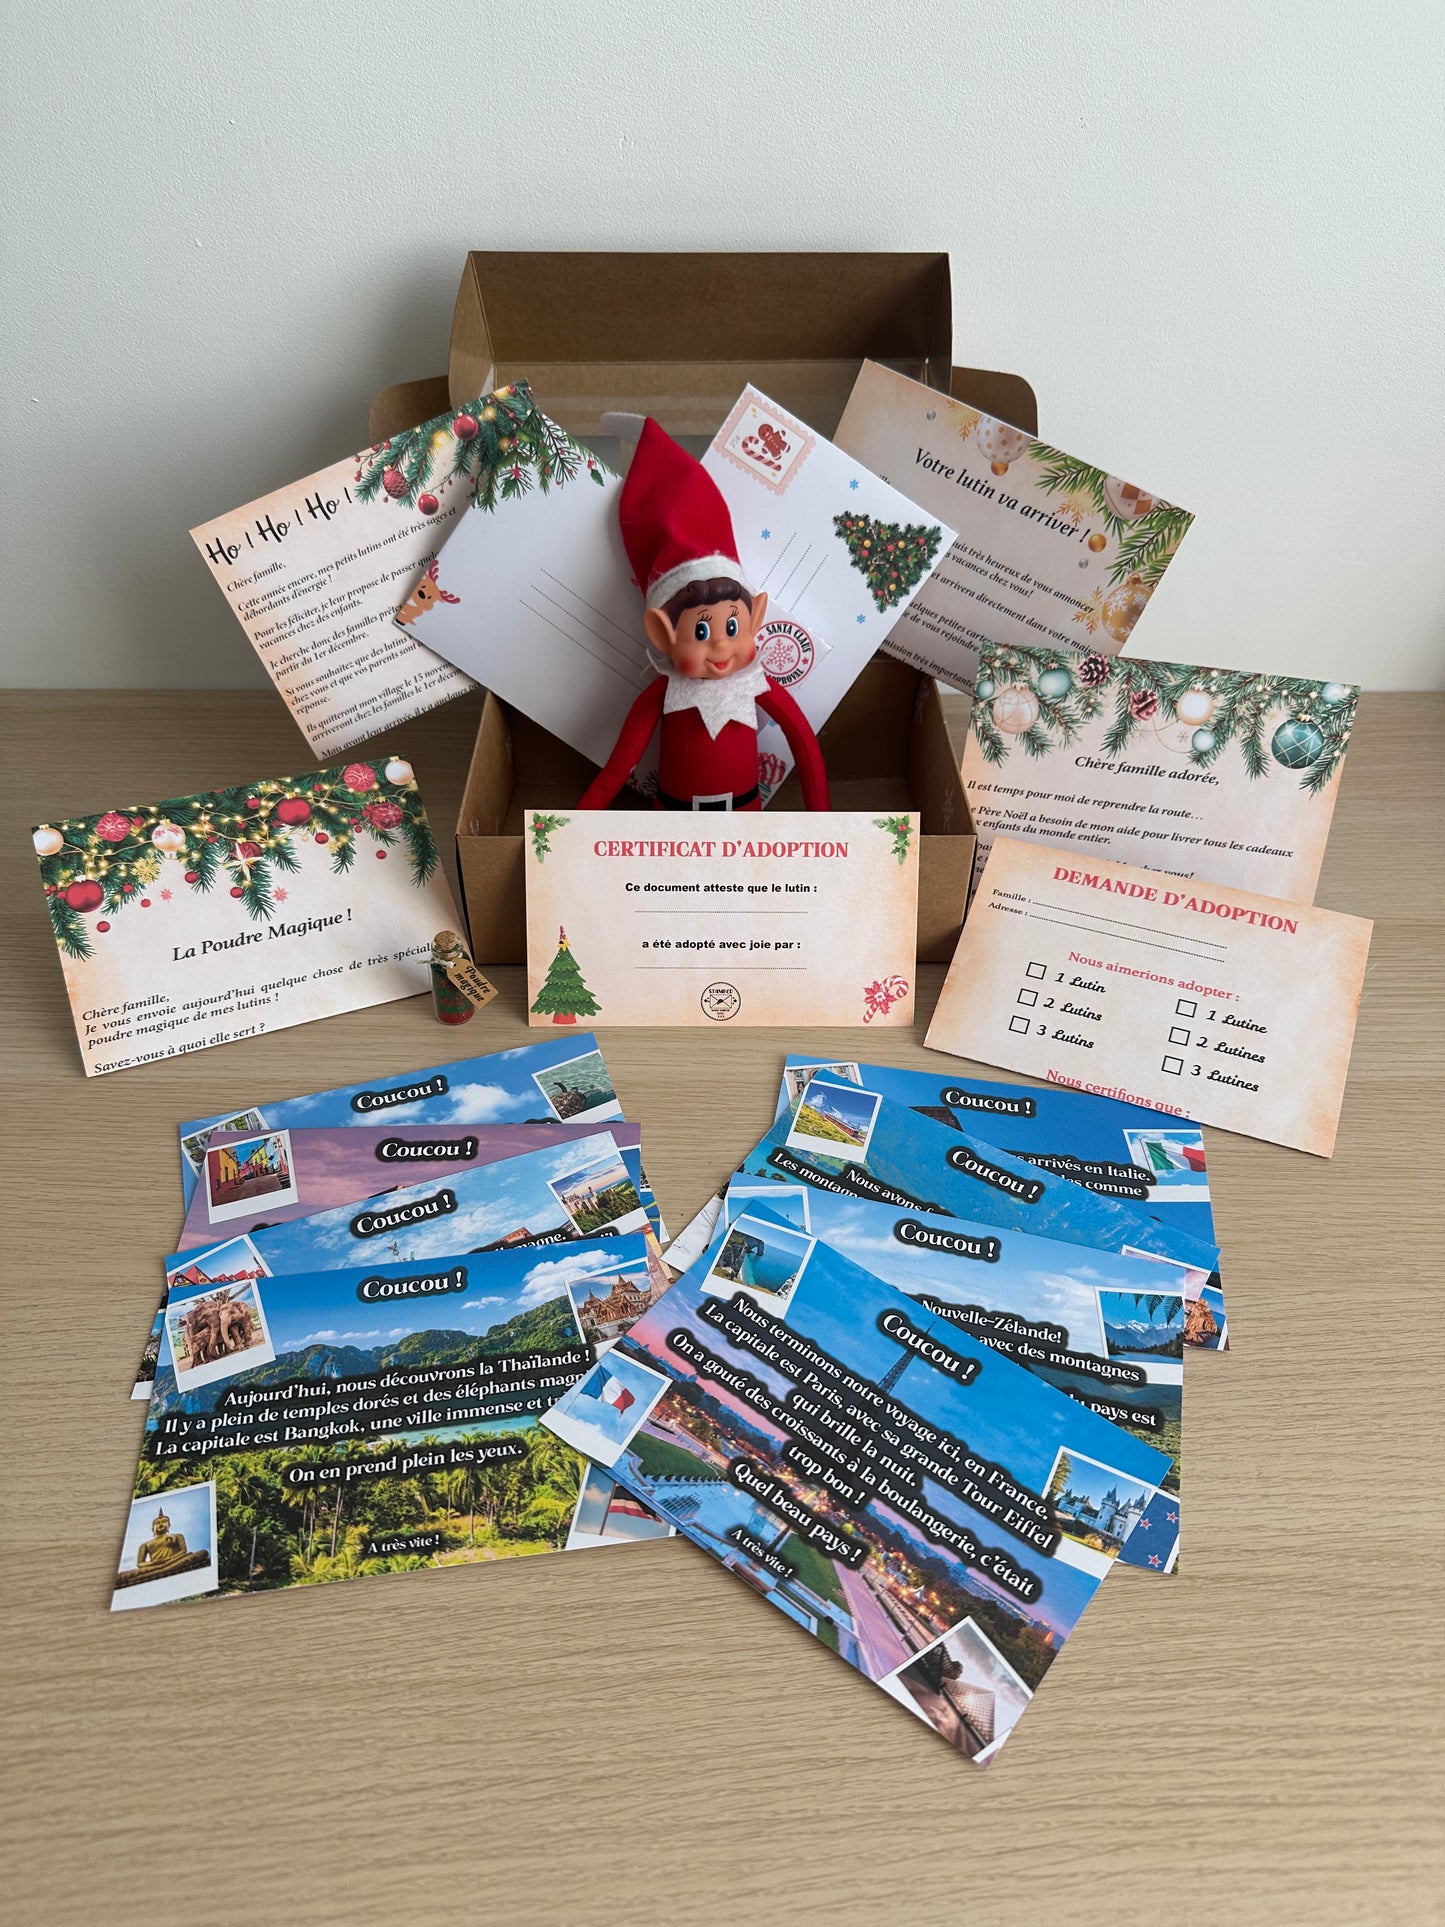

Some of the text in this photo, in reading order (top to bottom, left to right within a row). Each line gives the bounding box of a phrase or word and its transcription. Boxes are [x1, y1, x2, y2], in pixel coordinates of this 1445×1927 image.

[915, 447, 954, 479] Votre
[956, 468, 995, 498] lutin
[997, 493, 1018, 510] va
[1019, 505, 1079, 536] arriver
[206, 537, 241, 566] Ho
[255, 514, 290, 543] Ho
[304, 492, 339, 520] Ho
[227, 561, 286, 592] Chère famille,
[968, 547, 985, 560] très
[984, 554, 1020, 578] heureux
[1020, 573, 1032, 583] de
[1033, 580, 1053, 593] vous
[1052, 591, 1094, 613] annoncer
[765, 623, 812, 653] SANTA CLAUS
[1074, 756, 1219, 785] Chère famille adorée,
[966, 780, 1202, 820] Il est temps pour moi de reprendre la route…
[593, 840, 716, 857] CERTIFICAT
[625, 882, 640, 891] Ce
[643, 882, 700, 892] document
[703, 883, 744, 892] atteste
[747, 885, 768, 894] que
[771, 883, 781, 892] le
[785, 883, 810, 892] lutin
[992, 888, 1026, 901] Famille
[1053, 867, 1157, 901] DEMANDE
[988, 902, 1023, 915] Adresse
[173, 946, 196, 961] La
[201, 931, 263, 954] Poudre
[268, 914, 342, 939] Magique
[652, 939, 671, 948] été
[675, 939, 715, 950] adopté
[748, 939, 771, 950] joie
[774, 942, 794, 950] par
[454, 973, 485, 1002] magique
[465, 965, 490, 994] Poudre
[1054, 972, 1105, 993] 1 Lutin
[1068, 951, 1103, 968] Nous
[1105, 962, 1174, 985] aimerions
[1177, 980, 1233, 999] adopter
[82, 994, 169, 1020] Chère famille,
[1042, 997, 1102, 1021] 2 Lutins
[1206, 1010, 1267, 1033] 1 Lutine
[88, 1030, 132, 1050] poudre
[135, 1016, 189, 1035] magique
[193, 1010, 207, 1021] de
[210, 1005, 234, 1016] mes
[236, 996, 271, 1010] lutins
[1036, 1024, 1094, 1048] 3 Lutins
[94, 1049, 164, 1073] Savez-vous
[167, 1044, 175, 1055] à
[178, 1037, 206, 1054] quoi
[209, 1032, 230, 1044] elle
[233, 1025, 255, 1038] sert
[1195, 1036, 1265, 1063] 2 Lutines
[1045, 1068, 1081, 1087] Nous
[1085, 1083, 1151, 1107] certifions
[1190, 1064, 1259, 1092] 3 Lutines
[356, 1085, 432, 1108] Coucou
[945, 1091, 1019, 1112] Coucou
[382, 1138, 459, 1157] Coucou
[952, 1150, 1024, 1193] Coucou
[1027, 1157, 1151, 1182] arrivés en Italie.
[356, 1201, 439, 1232] Coucou
[900, 1223, 980, 1254] Coucou
[363, 1277, 448, 1297] Coucou
[883, 1314, 959, 1371] Coucou
[336, 1379, 376, 1393] nous
[379, 1367, 475, 1387] découvrons
[479, 1362, 493, 1375] la
[497, 1350, 580, 1372] Thaïlande
[733, 1298, 1050, 1520] Nous terminons notre voyage ici, en France.
[734, 1463, 774, 1496] Quel
[771, 1489, 811, 1526] beau
[808, 1524, 850, 1555] pays
[368, 1542, 377, 1553] A
[381, 1538, 406, 1551] très
[408, 1537, 432, 1547] vite
